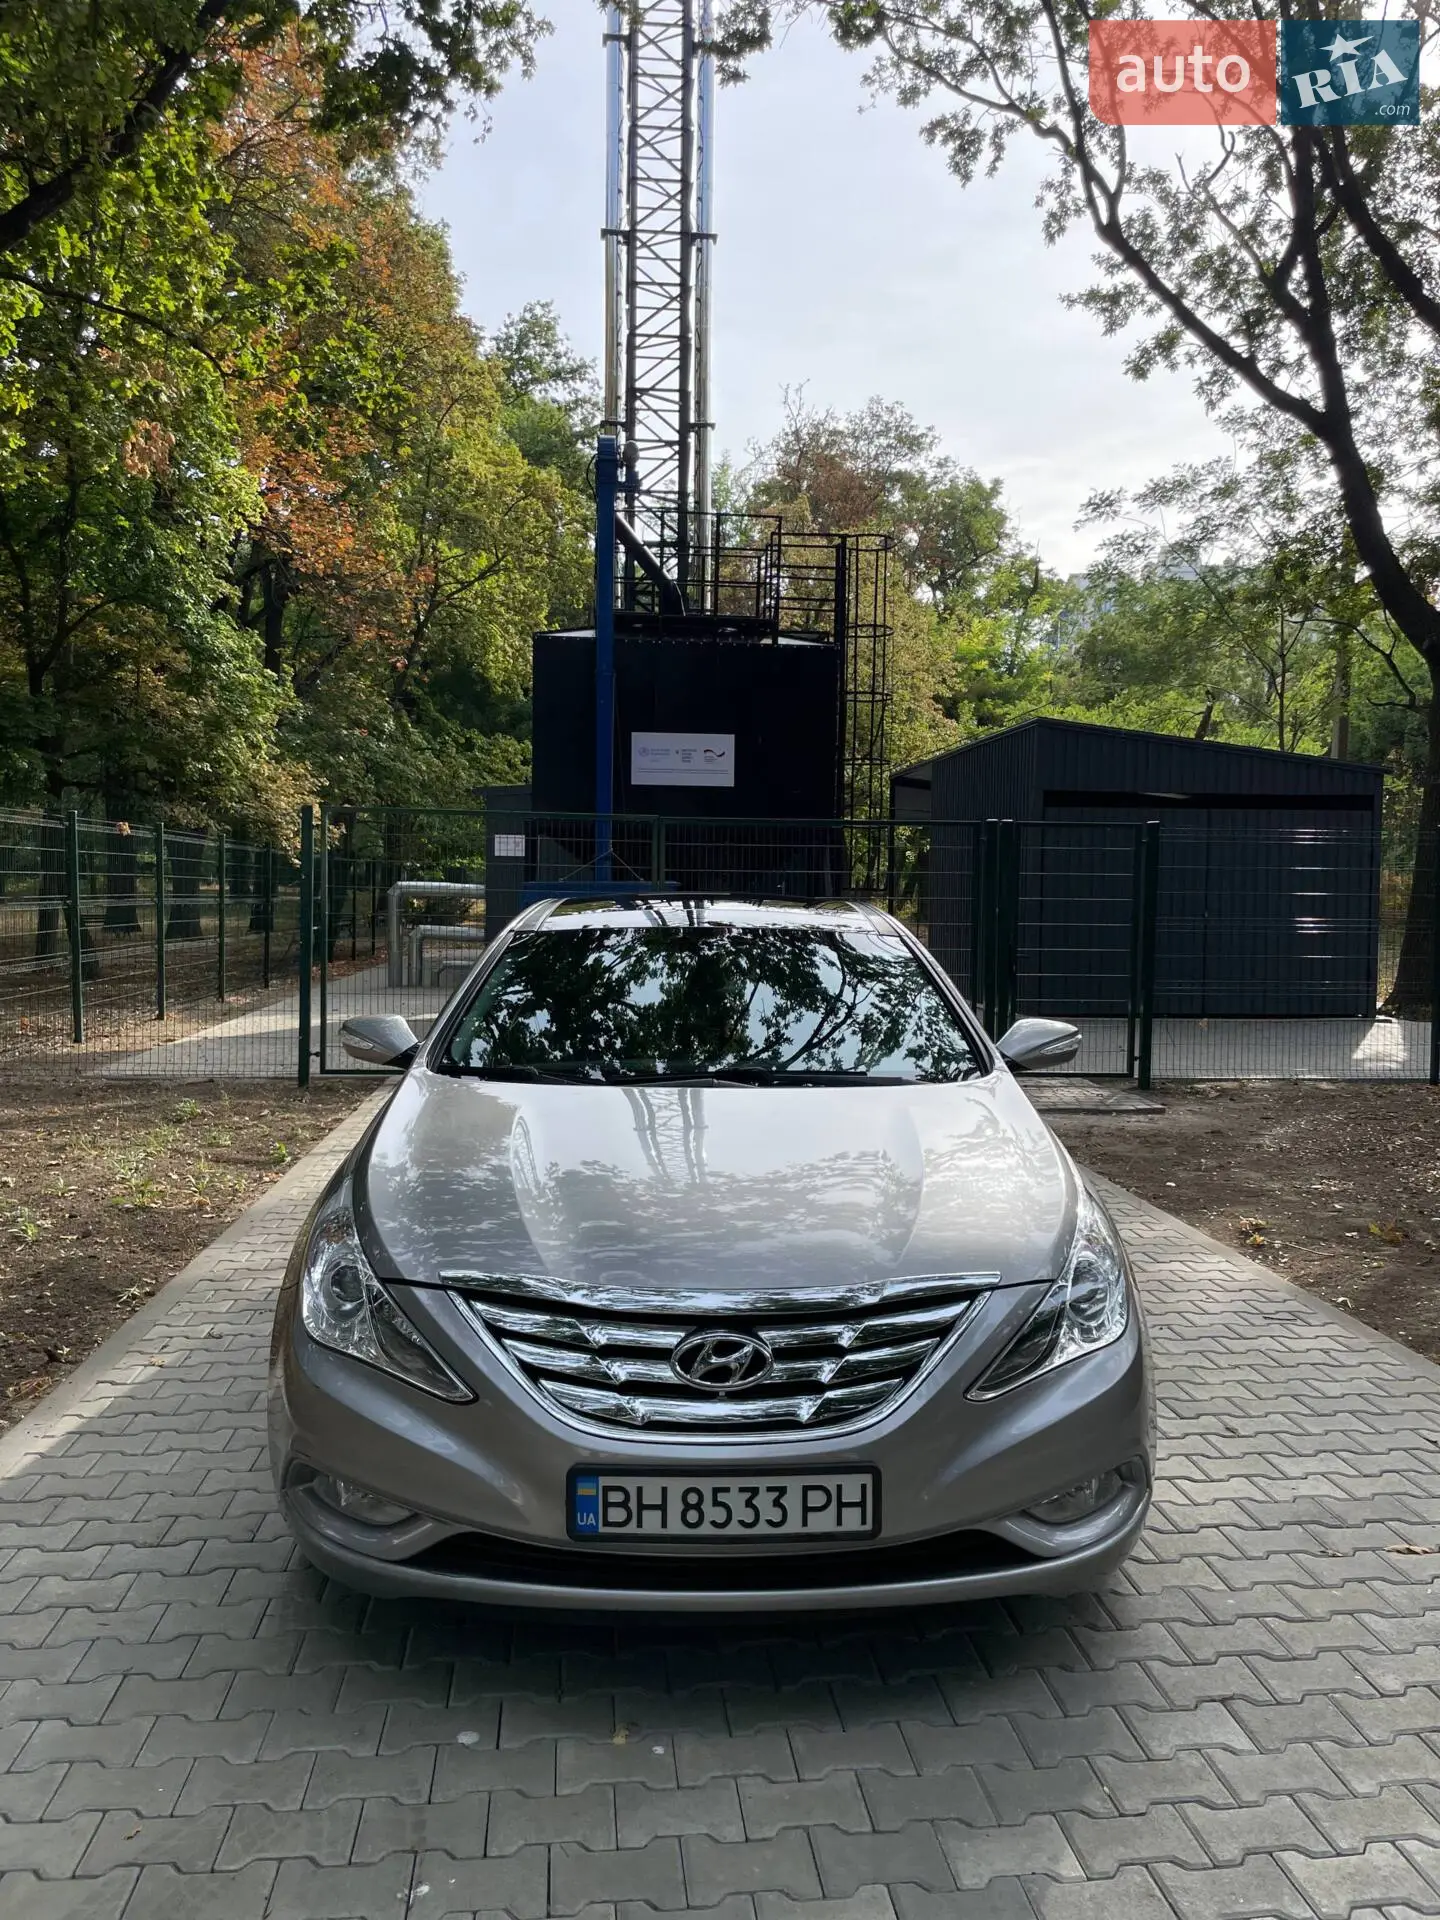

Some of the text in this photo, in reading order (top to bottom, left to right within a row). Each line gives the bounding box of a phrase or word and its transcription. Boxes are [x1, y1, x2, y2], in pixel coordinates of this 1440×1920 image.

[577, 1512, 596, 1526] UA
[602, 1483, 867, 1528] BH 8533 PH
